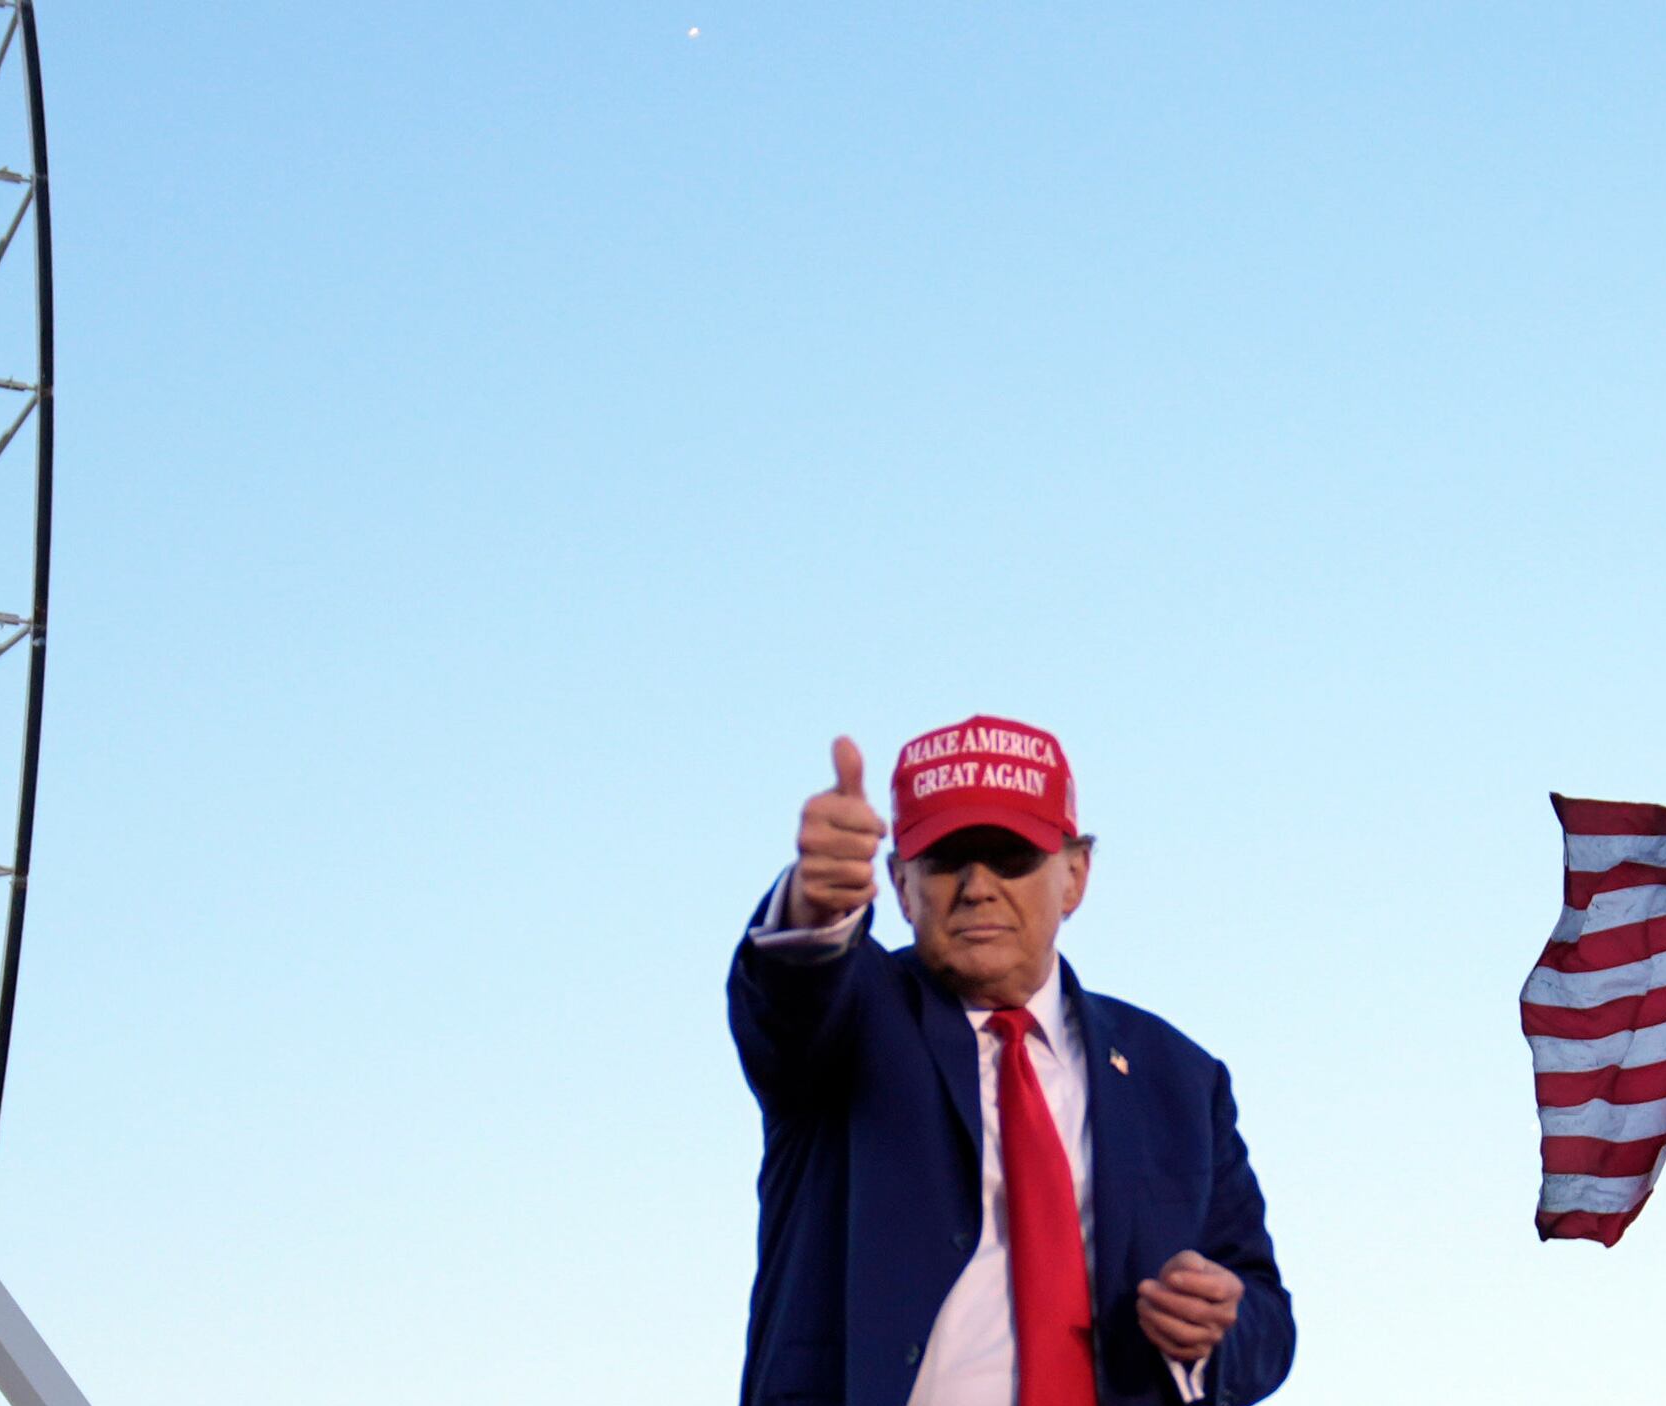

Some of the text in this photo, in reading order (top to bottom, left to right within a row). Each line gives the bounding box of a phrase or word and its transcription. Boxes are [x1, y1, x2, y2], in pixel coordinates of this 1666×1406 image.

[904, 727, 1057, 767] MAKE AMERICA
[913, 762, 1046, 799] GREAT AGAIN
